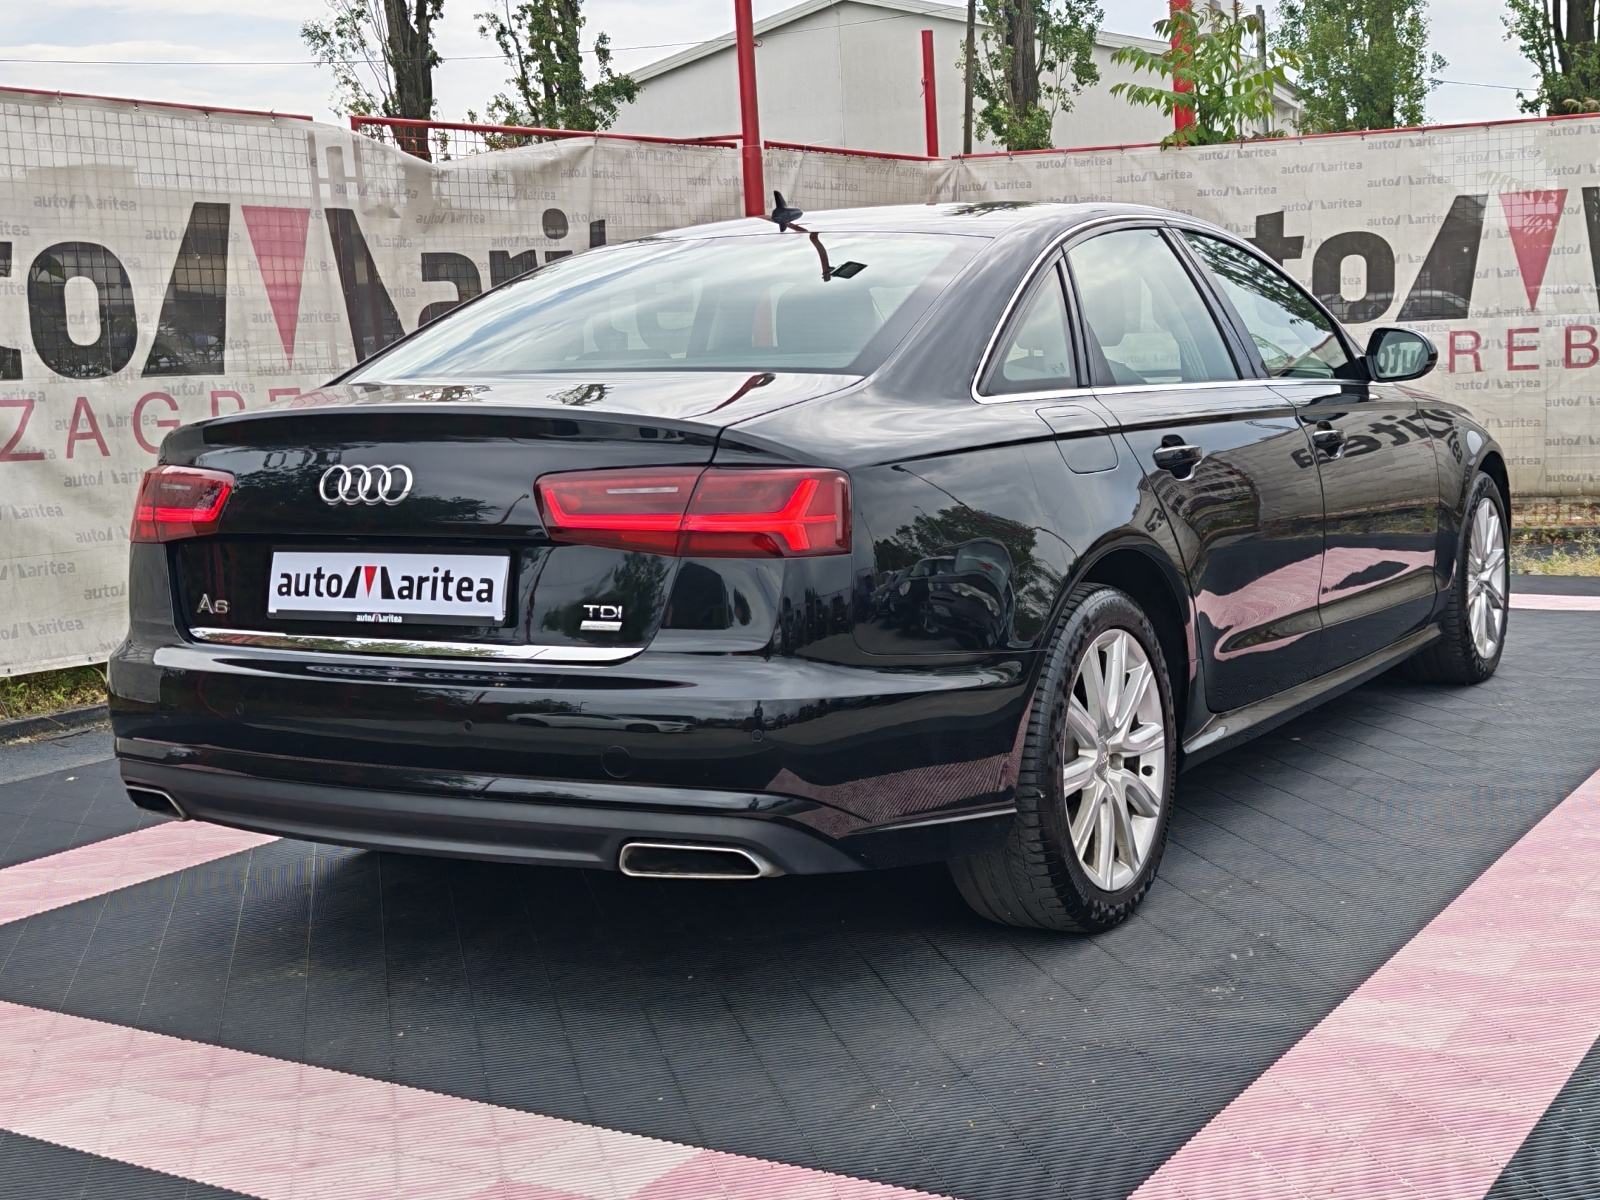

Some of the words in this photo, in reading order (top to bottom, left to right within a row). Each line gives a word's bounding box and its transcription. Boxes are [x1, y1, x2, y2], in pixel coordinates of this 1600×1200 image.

[277, 565, 494, 603] autoMaritea
[196, 593, 229, 615] A6
[583, 604, 623, 619] TDI
